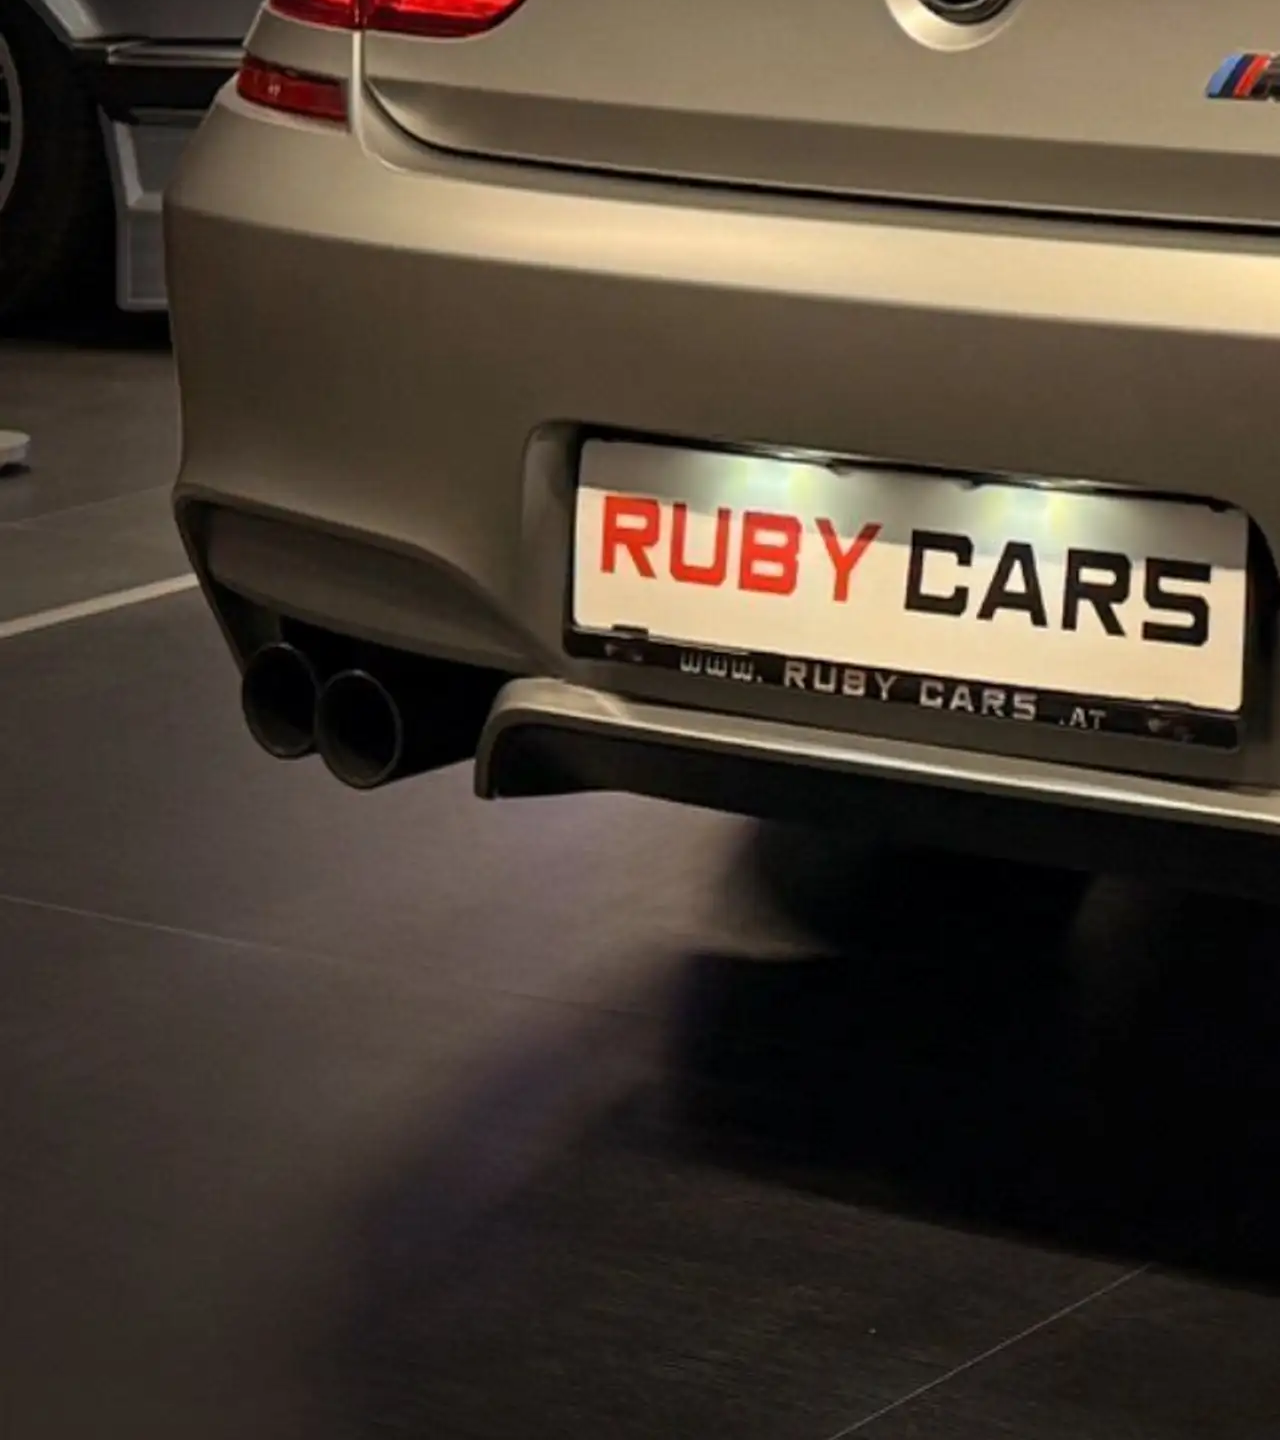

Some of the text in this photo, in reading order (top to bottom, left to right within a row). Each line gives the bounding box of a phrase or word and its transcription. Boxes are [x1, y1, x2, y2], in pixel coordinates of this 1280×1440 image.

[600, 495, 1212, 648] RUBY CARS
[784, 660, 898, 701] RUBY
[919, 679, 1038, 722] CARS
